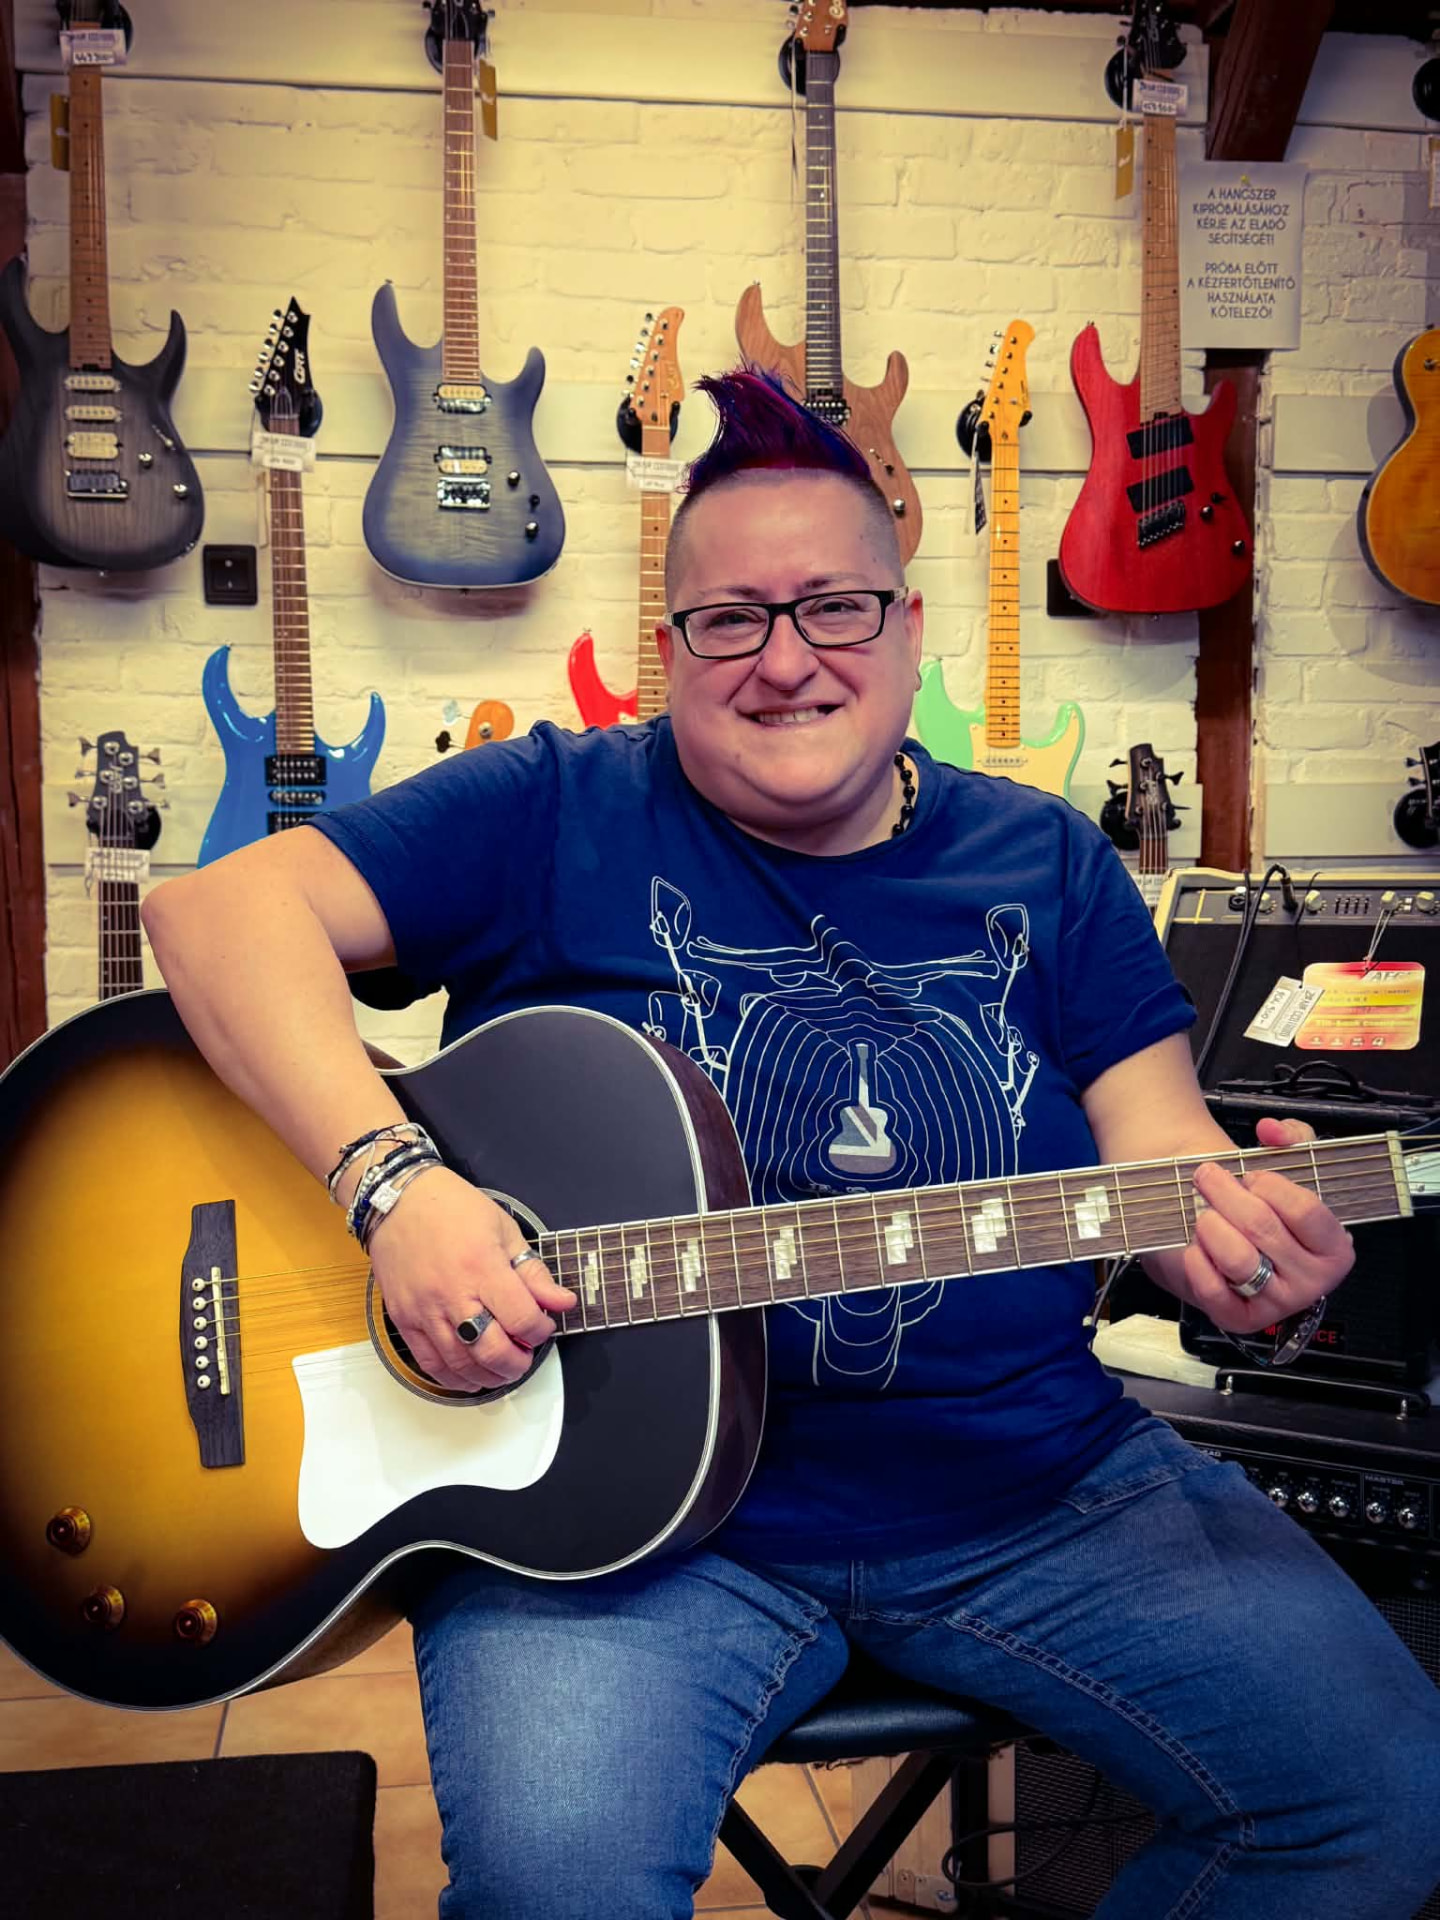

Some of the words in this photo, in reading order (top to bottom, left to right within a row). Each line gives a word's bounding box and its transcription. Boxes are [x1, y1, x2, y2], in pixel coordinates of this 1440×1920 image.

[1208, 188, 1216, 199] A
[1219, 188, 1276, 200] HANGSZER
[1193, 202, 1290, 216] KIPRÓBÁLÁSÁHOZ
[1197, 216, 1227, 229] KÉRJE
[1230, 218, 1246, 230] AZ
[1249, 217, 1286, 230] ELADÓ
[1205, 261, 1241, 274] PRÓBA
[1244, 261, 1278, 274] ELŐTT
[1187, 277, 1195, 288] A
[1207, 291, 1276, 304] HASZNÁLATA
